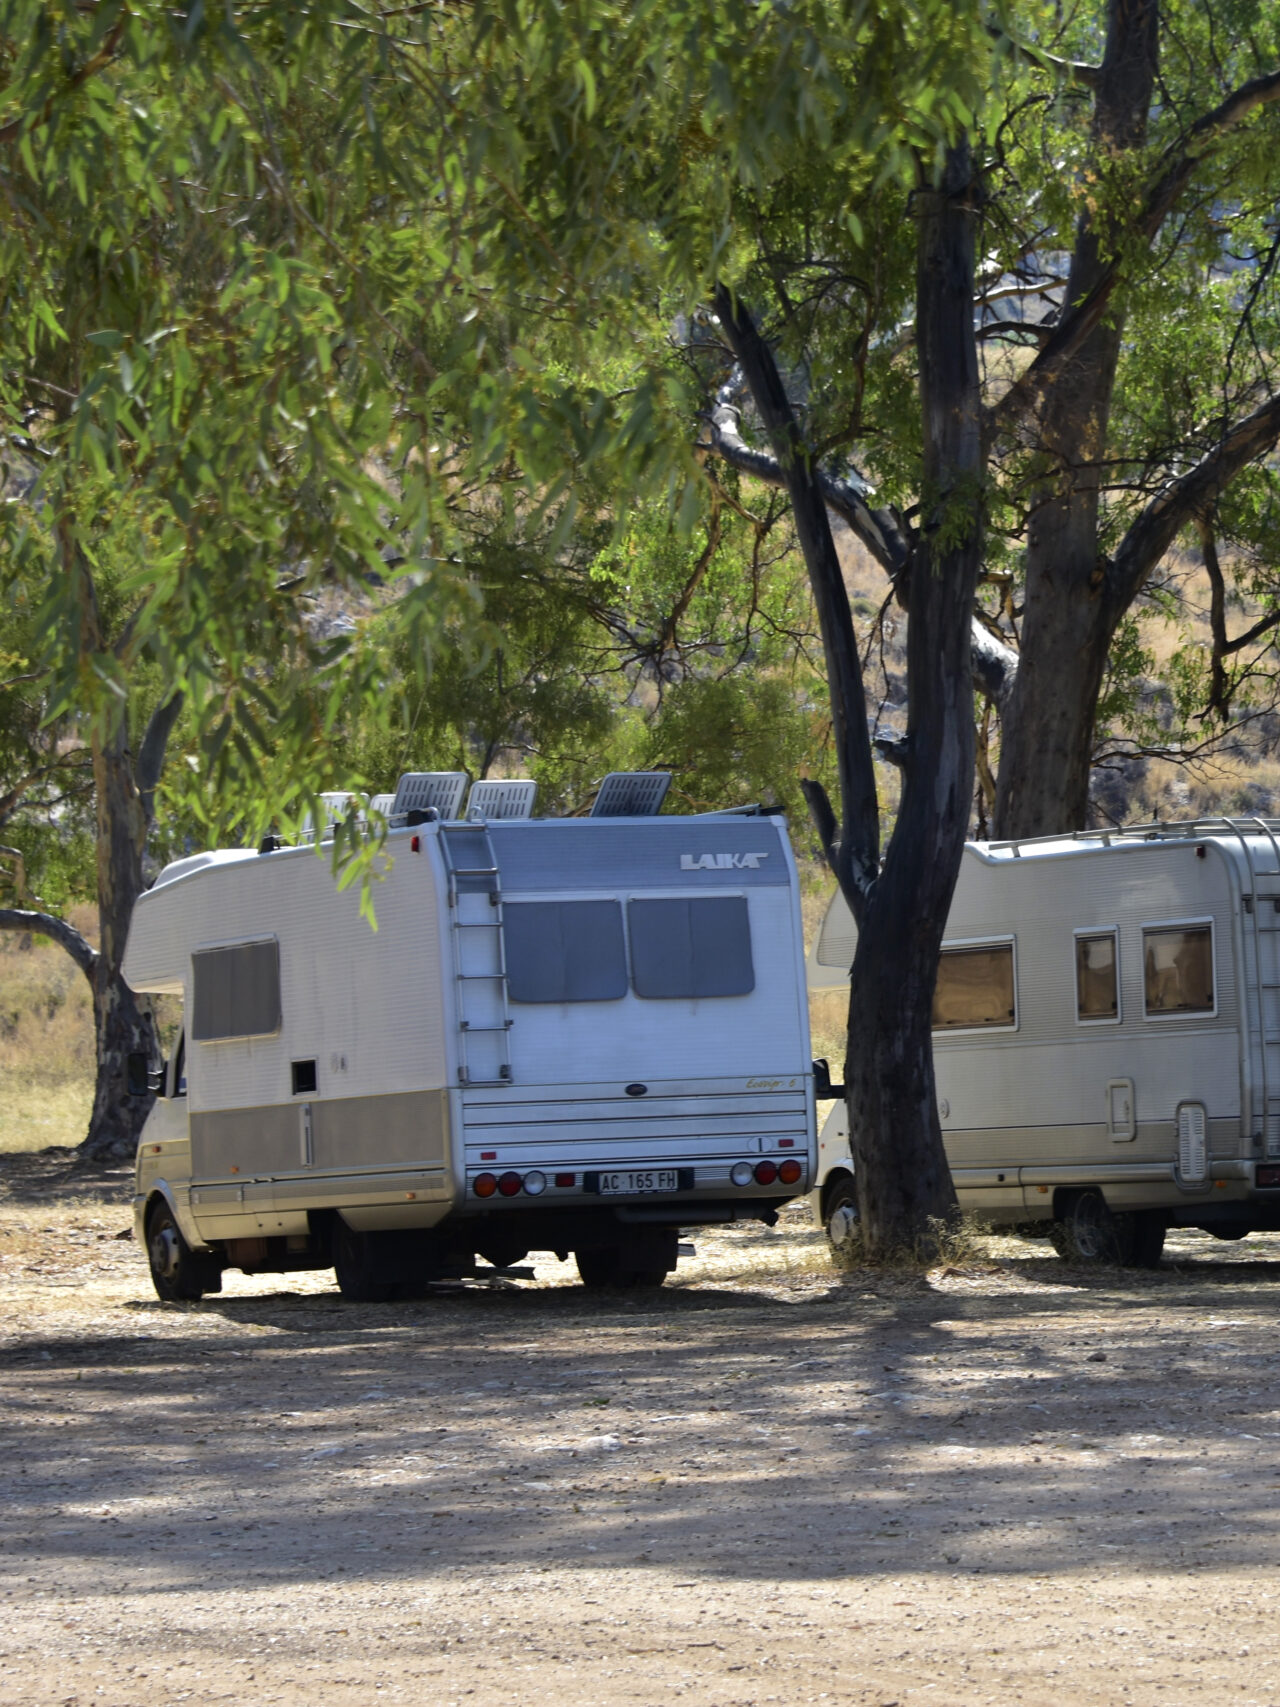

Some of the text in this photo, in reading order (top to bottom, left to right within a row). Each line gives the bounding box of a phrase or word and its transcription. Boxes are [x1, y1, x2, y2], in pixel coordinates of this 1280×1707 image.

[680, 853, 769, 870] LAIKA
[602, 1172, 676, 1190] AC 165 FH
